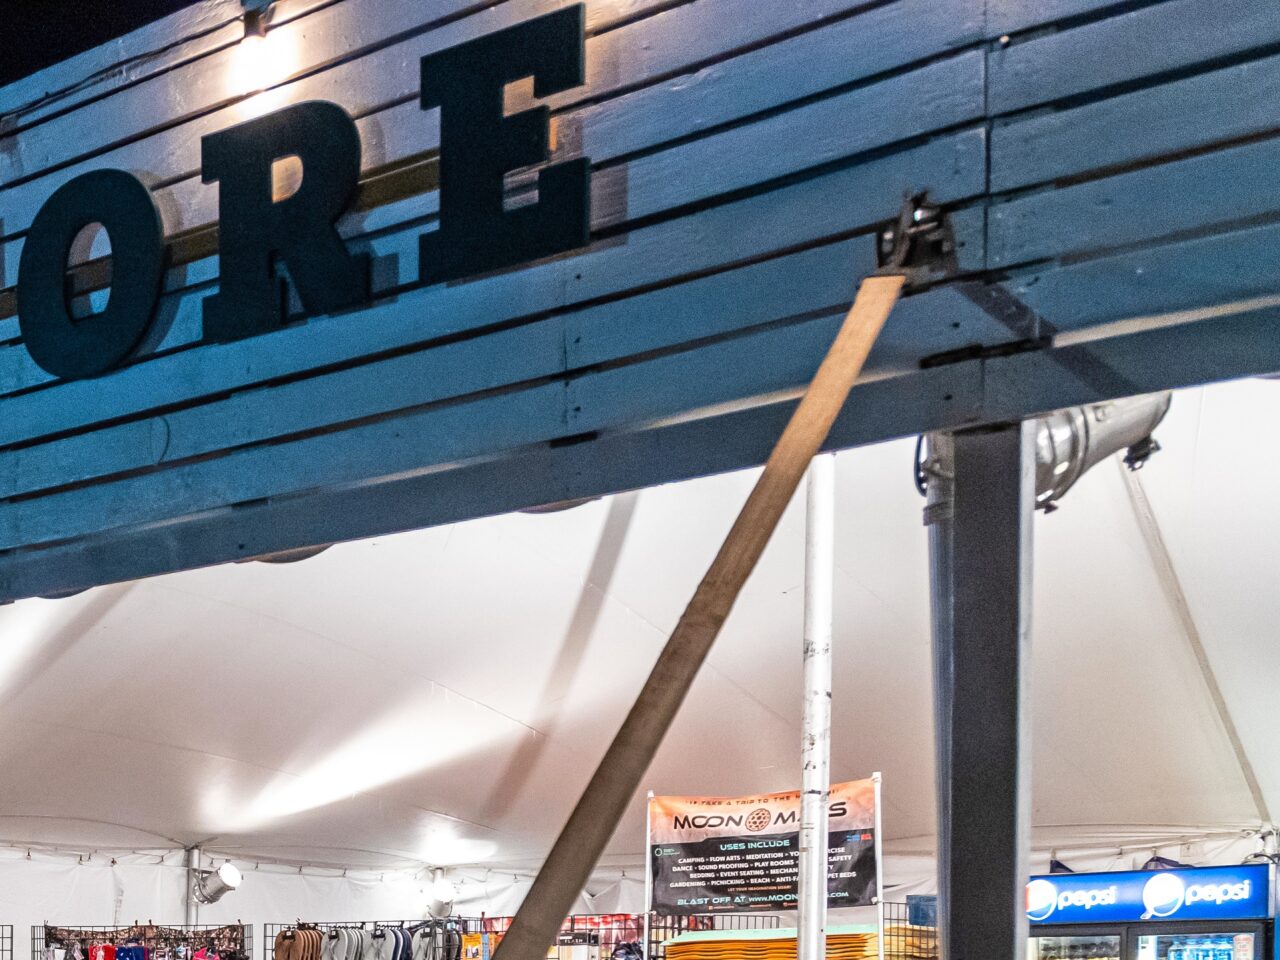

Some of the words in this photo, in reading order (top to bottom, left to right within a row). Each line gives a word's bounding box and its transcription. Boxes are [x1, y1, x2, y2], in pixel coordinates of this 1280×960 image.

[674, 815, 743, 830] MOON
[774, 802, 847, 825] MS
[720, 842, 745, 850] USES
[748, 840, 790, 849] INCLUDE
[1058, 885, 1117, 910] pepsi
[1185, 880, 1251, 906] pepsi
